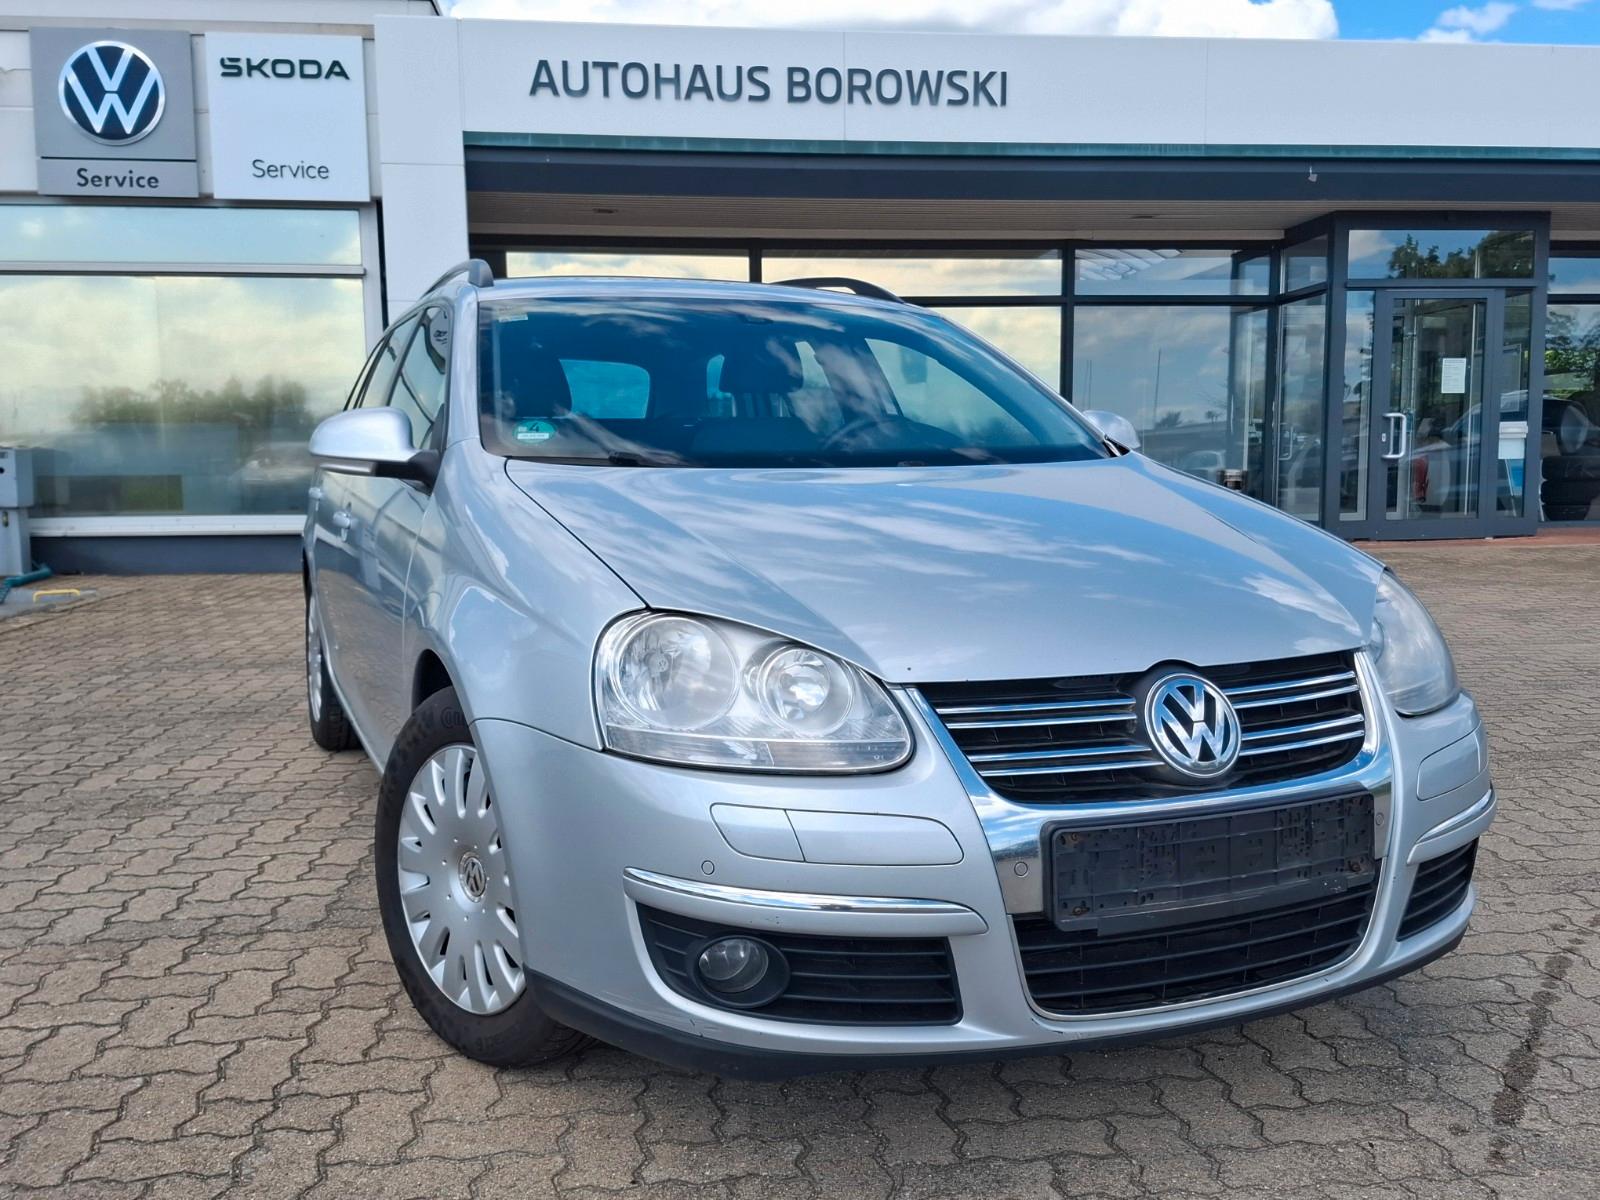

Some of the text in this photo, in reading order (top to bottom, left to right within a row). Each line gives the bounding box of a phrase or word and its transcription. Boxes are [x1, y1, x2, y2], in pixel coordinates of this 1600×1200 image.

[65, 45, 158, 136] VW
[529, 59, 1007, 107] AUTOHAUS BOROWSKI
[76, 167, 160, 189] Service
[252, 159, 329, 179] Service
[529, 421, 540, 432] 4
[1153, 679, 1233, 766] VW
